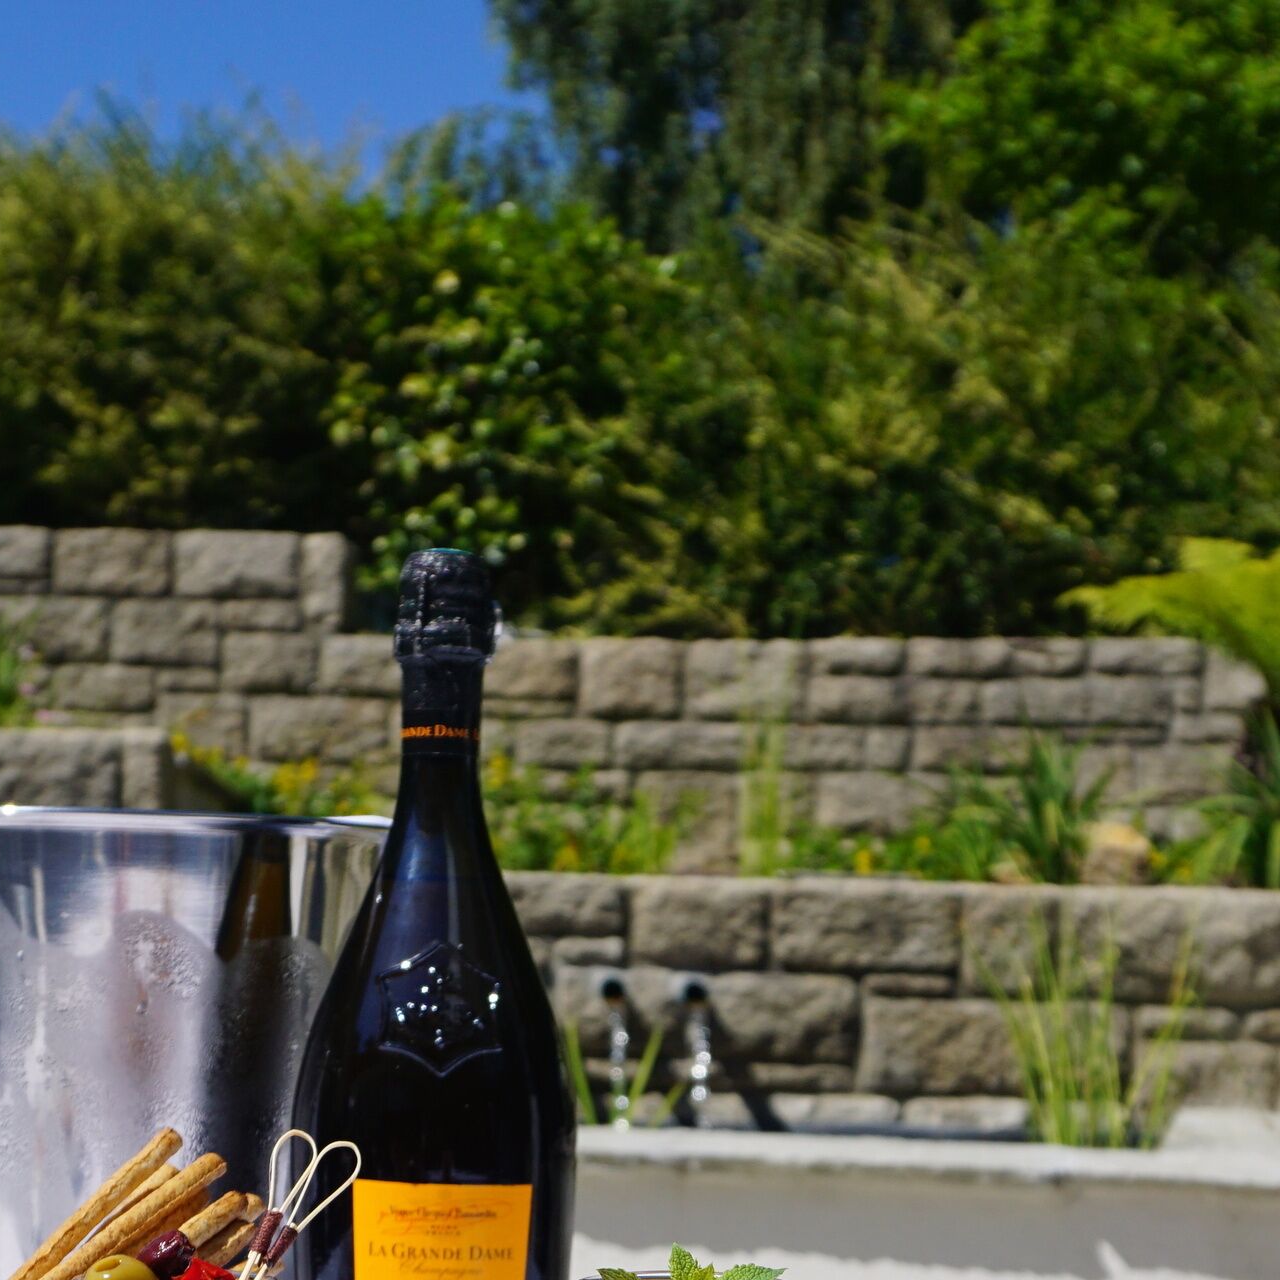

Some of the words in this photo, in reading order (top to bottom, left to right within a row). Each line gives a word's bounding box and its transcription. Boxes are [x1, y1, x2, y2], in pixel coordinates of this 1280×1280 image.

[369, 1241, 387, 1257] LA
[391, 1242, 462, 1260] GRANDE
[469, 1244, 513, 1260] DAME
